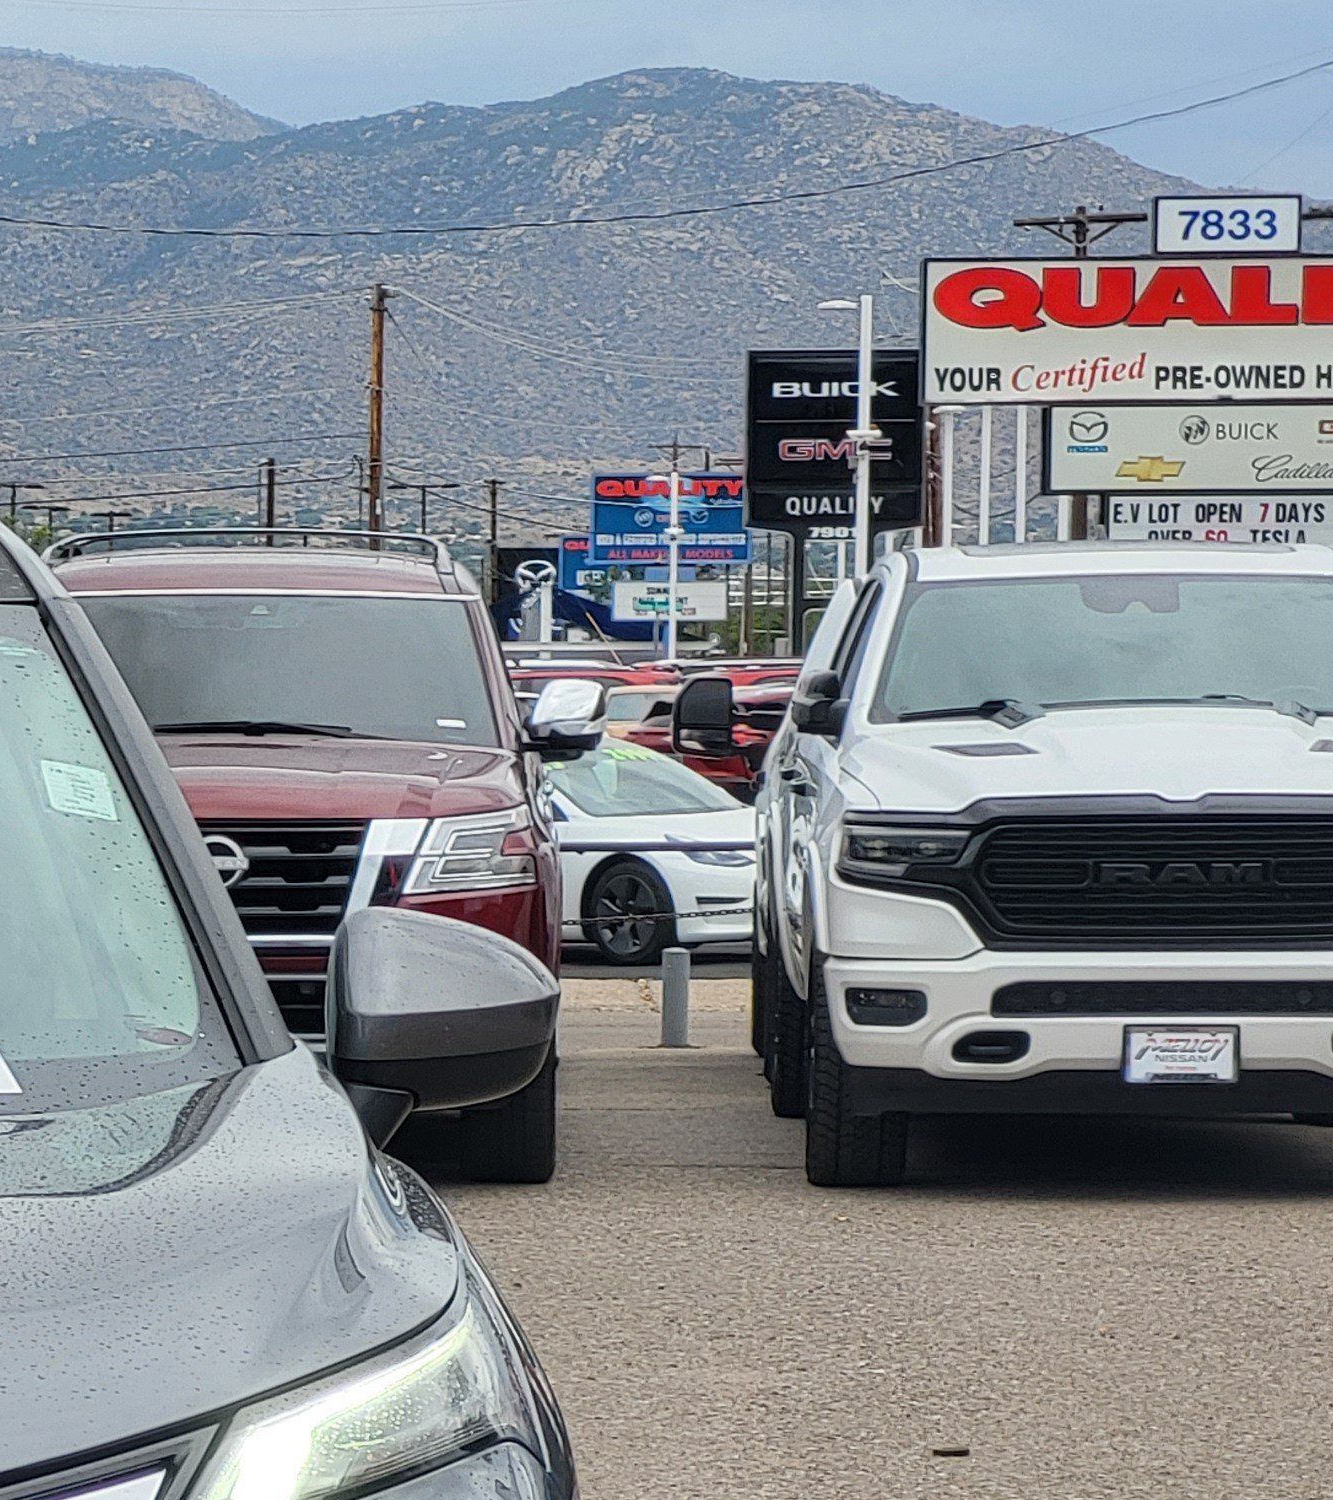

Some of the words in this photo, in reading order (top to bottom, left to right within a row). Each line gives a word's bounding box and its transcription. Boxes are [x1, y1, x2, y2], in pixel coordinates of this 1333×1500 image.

[1178, 209, 1278, 241] 7833
[934, 367, 1002, 392] YOUR
[1011, 352, 1147, 393] Certified
[1154, 365, 1305, 390] PRE-OWNED
[1215, 422, 1279, 441] BUICK
[784, 496, 884, 517] QUALIY
[1148, 503, 1181, 523] LOT
[1195, 503, 1242, 524] OPEN
[1259, 503, 1269, 522] 7
[1275, 503, 1326, 523] DAYS
[1099, 863, 1264, 885] RAM
[1153, 1053, 1210, 1063] NISSAN
